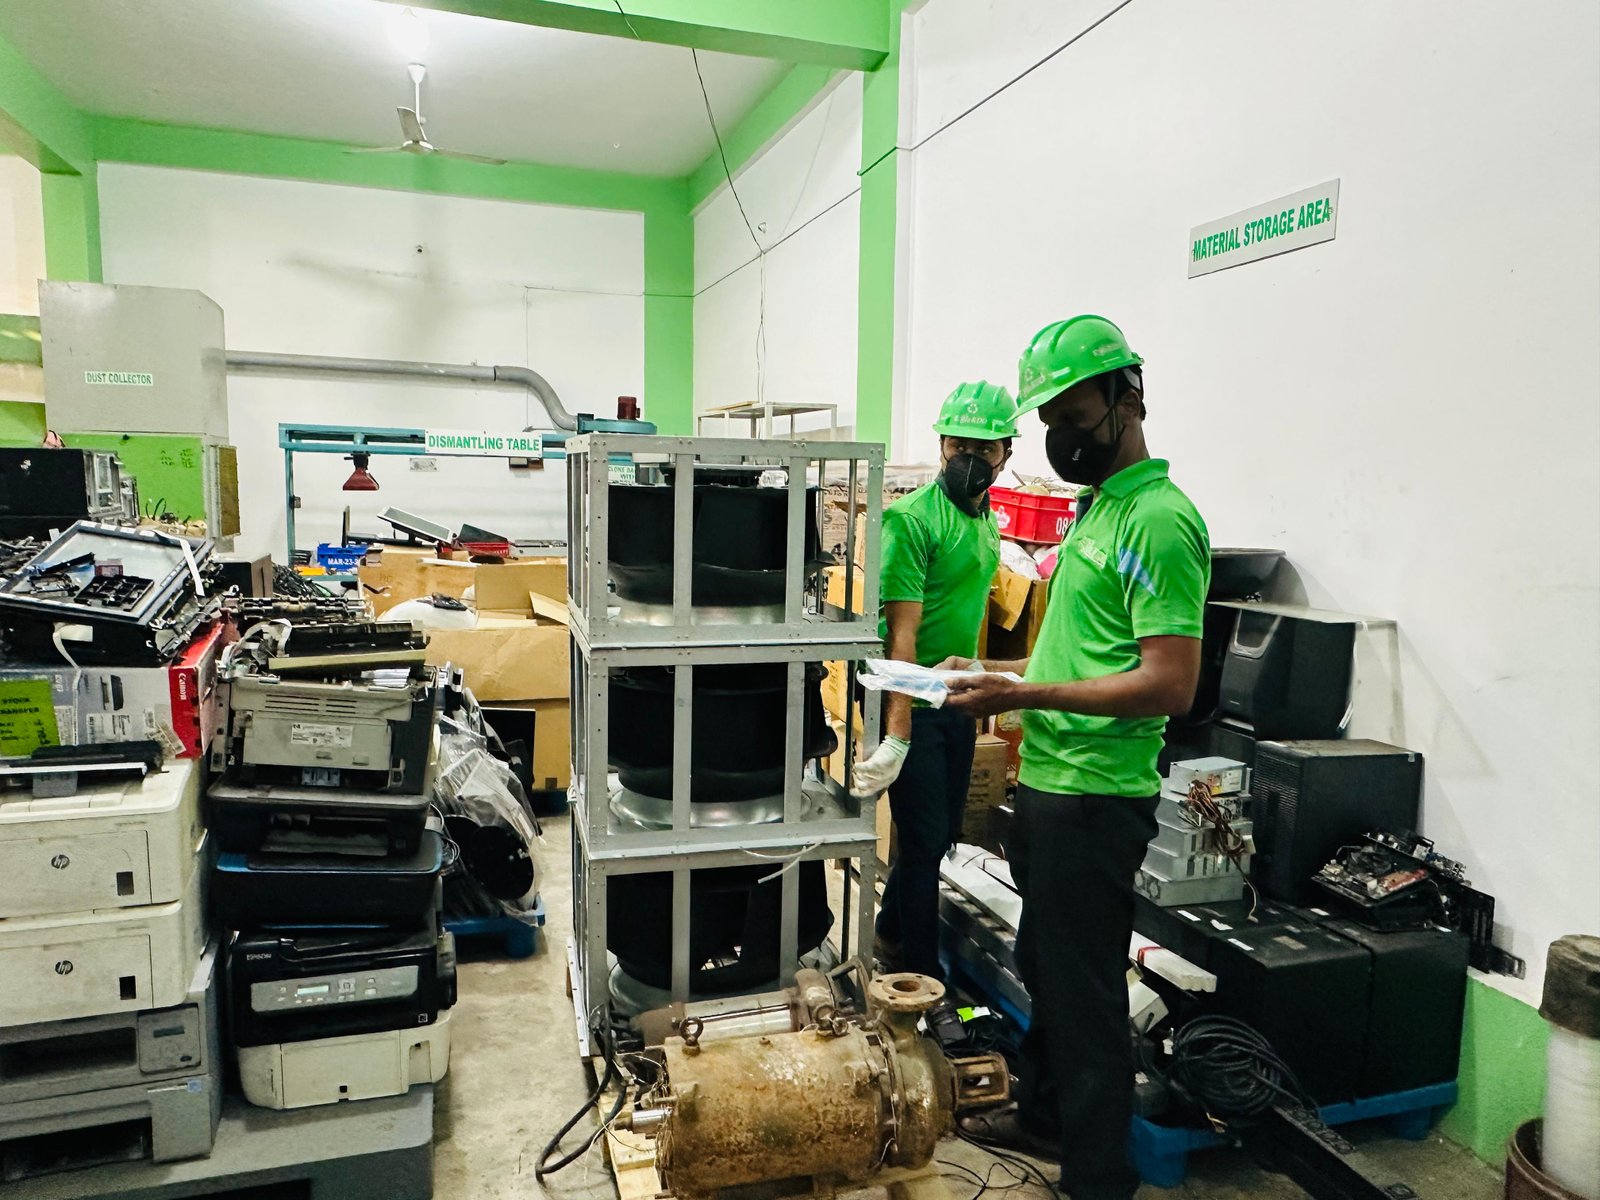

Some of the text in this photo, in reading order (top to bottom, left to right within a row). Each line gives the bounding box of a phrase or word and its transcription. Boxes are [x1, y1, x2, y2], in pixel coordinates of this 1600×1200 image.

[1193, 198, 1330, 262] MATERIAL STORAGE AREA
[86, 372, 152, 385] DUST COLLECTOR
[428, 435, 540, 451] DISMANTLING TABLE
